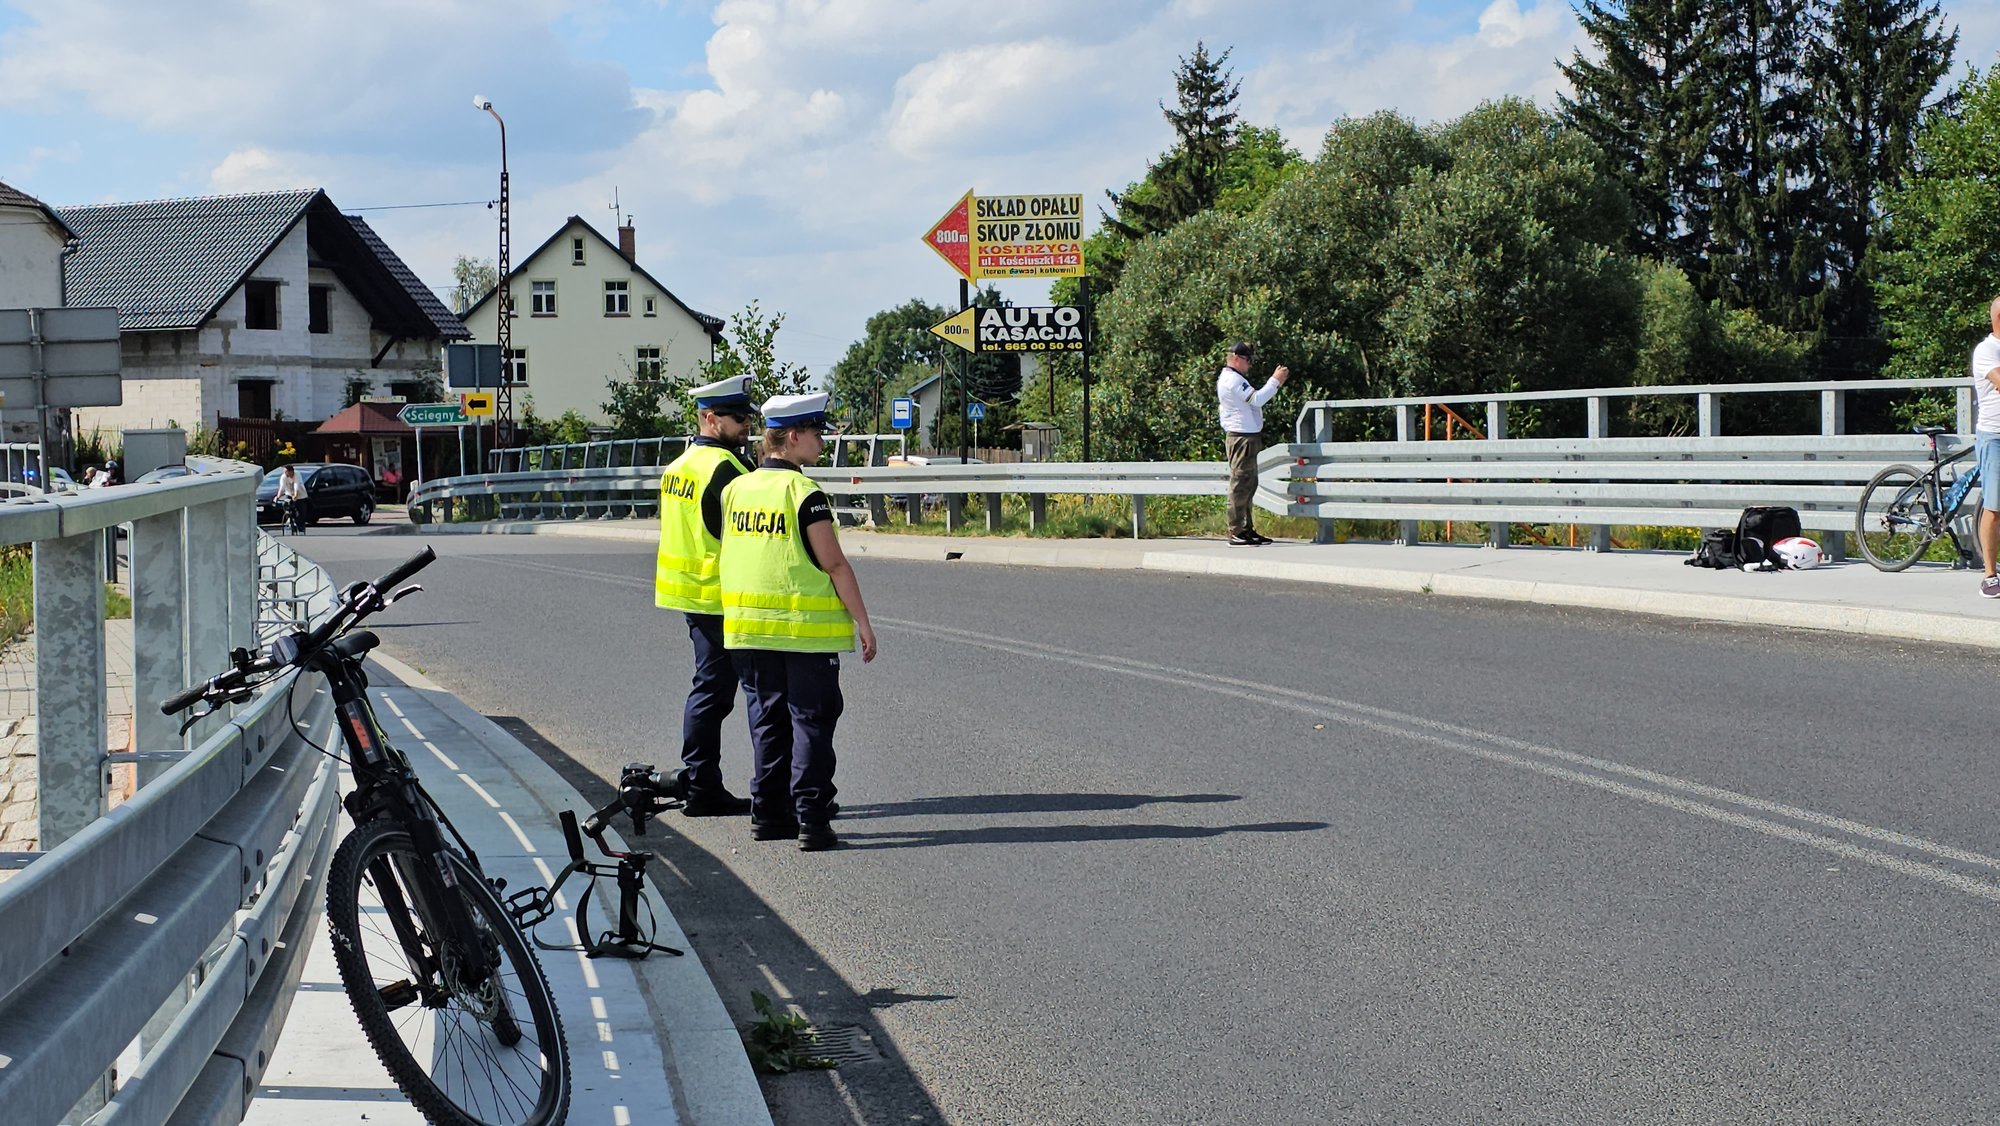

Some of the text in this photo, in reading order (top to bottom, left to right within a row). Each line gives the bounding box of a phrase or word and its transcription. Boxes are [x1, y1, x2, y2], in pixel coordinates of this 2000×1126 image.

[977, 197, 1079, 217] SKŁAD OPAŁU
[977, 222, 1080, 242] SKUP ZŁOMU
[978, 243, 1080, 255] KOSTRZYCA
[981, 255, 1077, 266] ul. Kościuszki 142
[980, 307, 1080, 327] AUTO
[980, 326, 1083, 342] KASACJA
[982, 341, 1083, 351] tel. 665 00 50 40
[732, 510, 786, 535] POLICJA
